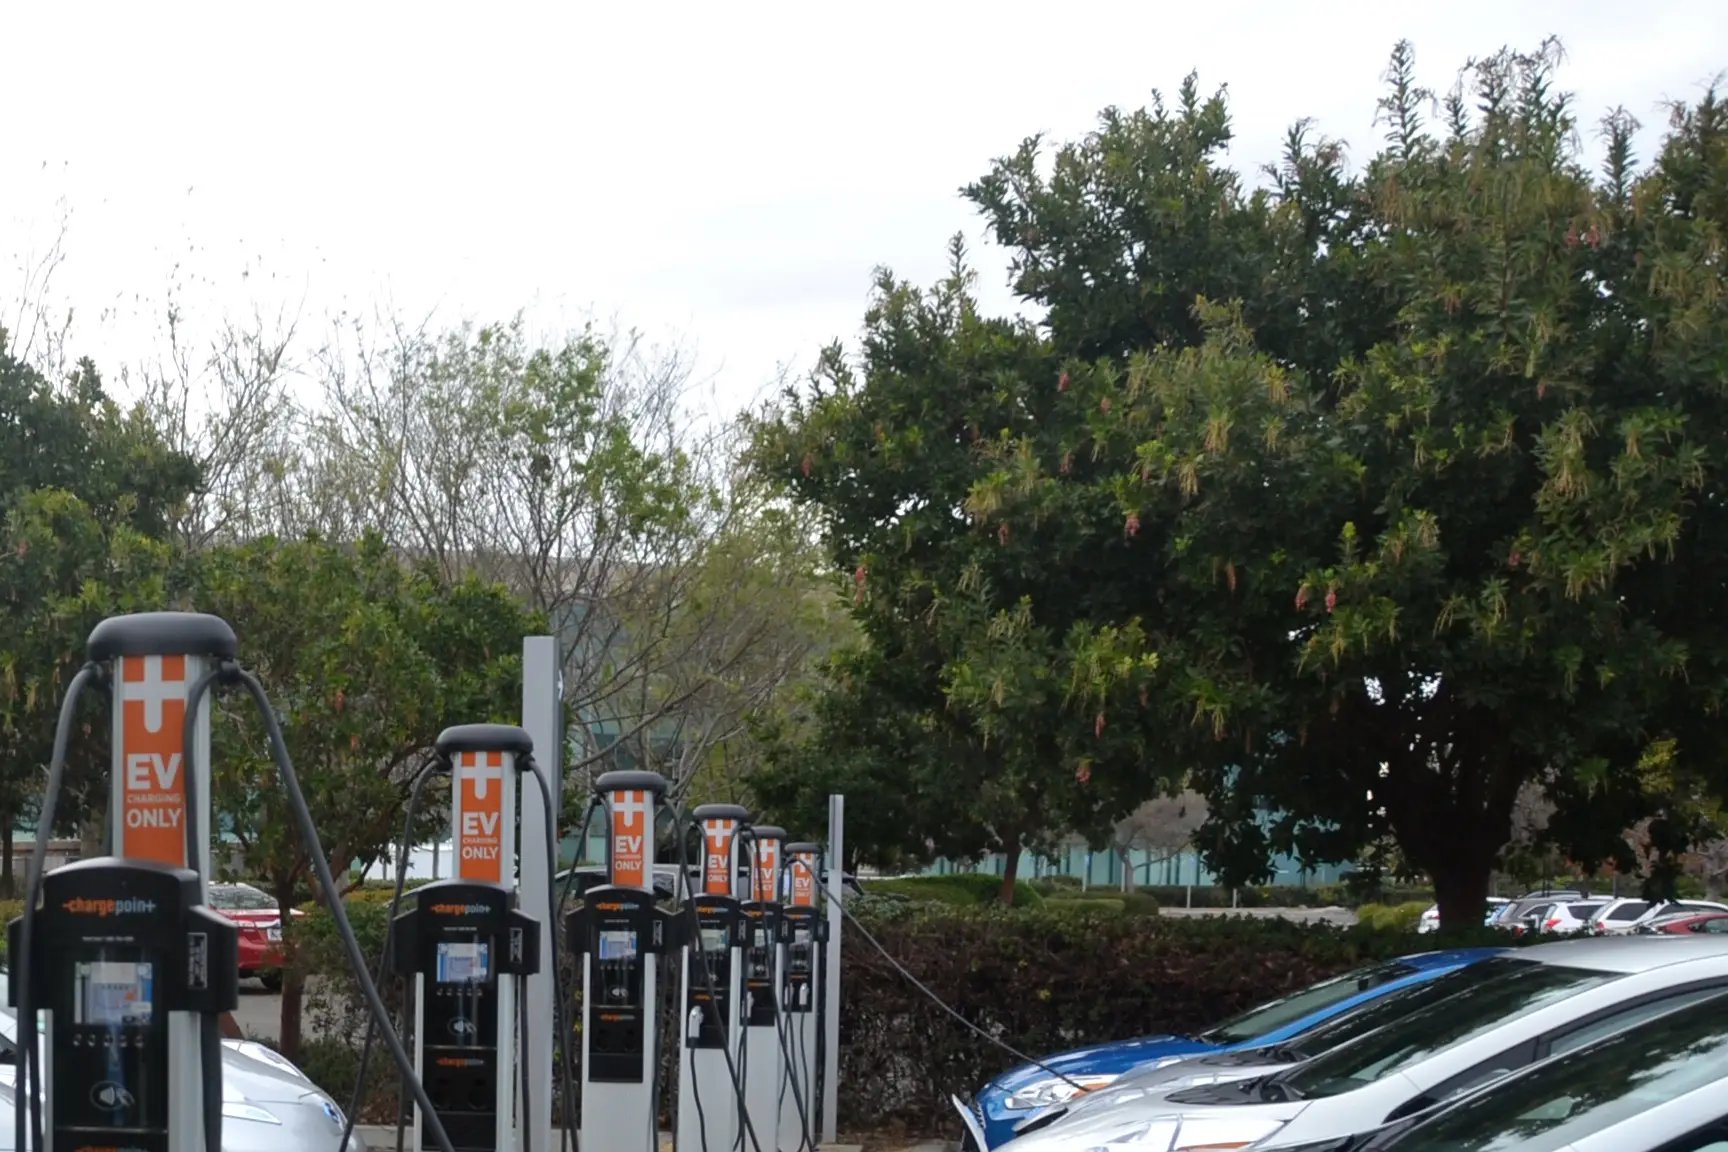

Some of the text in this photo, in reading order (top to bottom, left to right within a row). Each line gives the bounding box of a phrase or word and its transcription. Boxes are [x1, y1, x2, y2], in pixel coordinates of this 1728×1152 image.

[127, 753, 182, 790] EV
[127, 793, 181, 803] CHARGING
[126, 807, 182, 828] ONLY
[462, 811, 499, 836] EV
[462, 846, 499, 860] ONLY
[615, 835, 642, 854] EV
[615, 860, 642, 871] ONLY
[707, 854, 729, 869] EV
